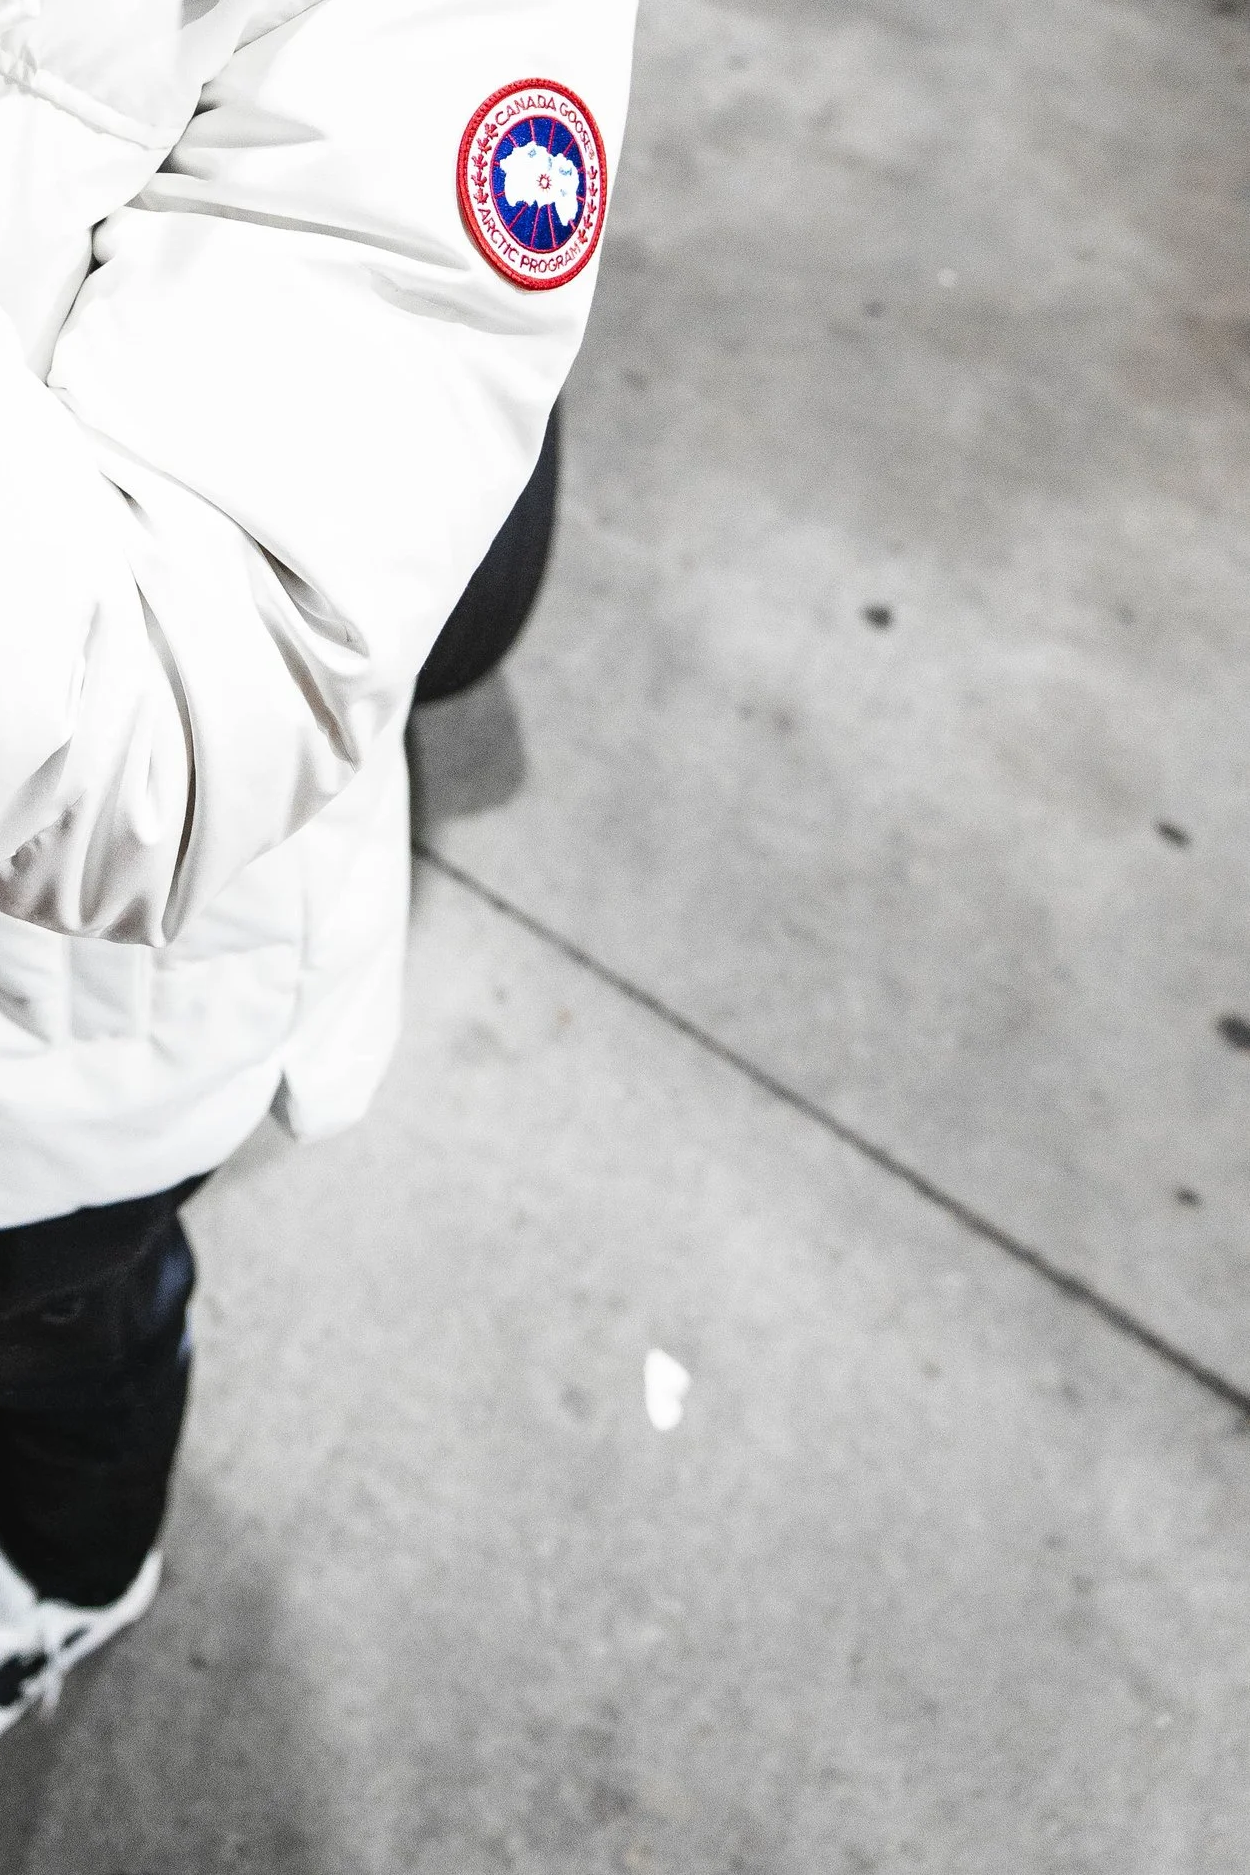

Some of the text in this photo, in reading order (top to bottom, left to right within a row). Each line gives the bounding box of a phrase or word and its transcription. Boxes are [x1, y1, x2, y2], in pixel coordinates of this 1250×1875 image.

[495, 94, 557, 127] CANADA
[478, 208, 581, 274] ARCTIC PROGRAM
